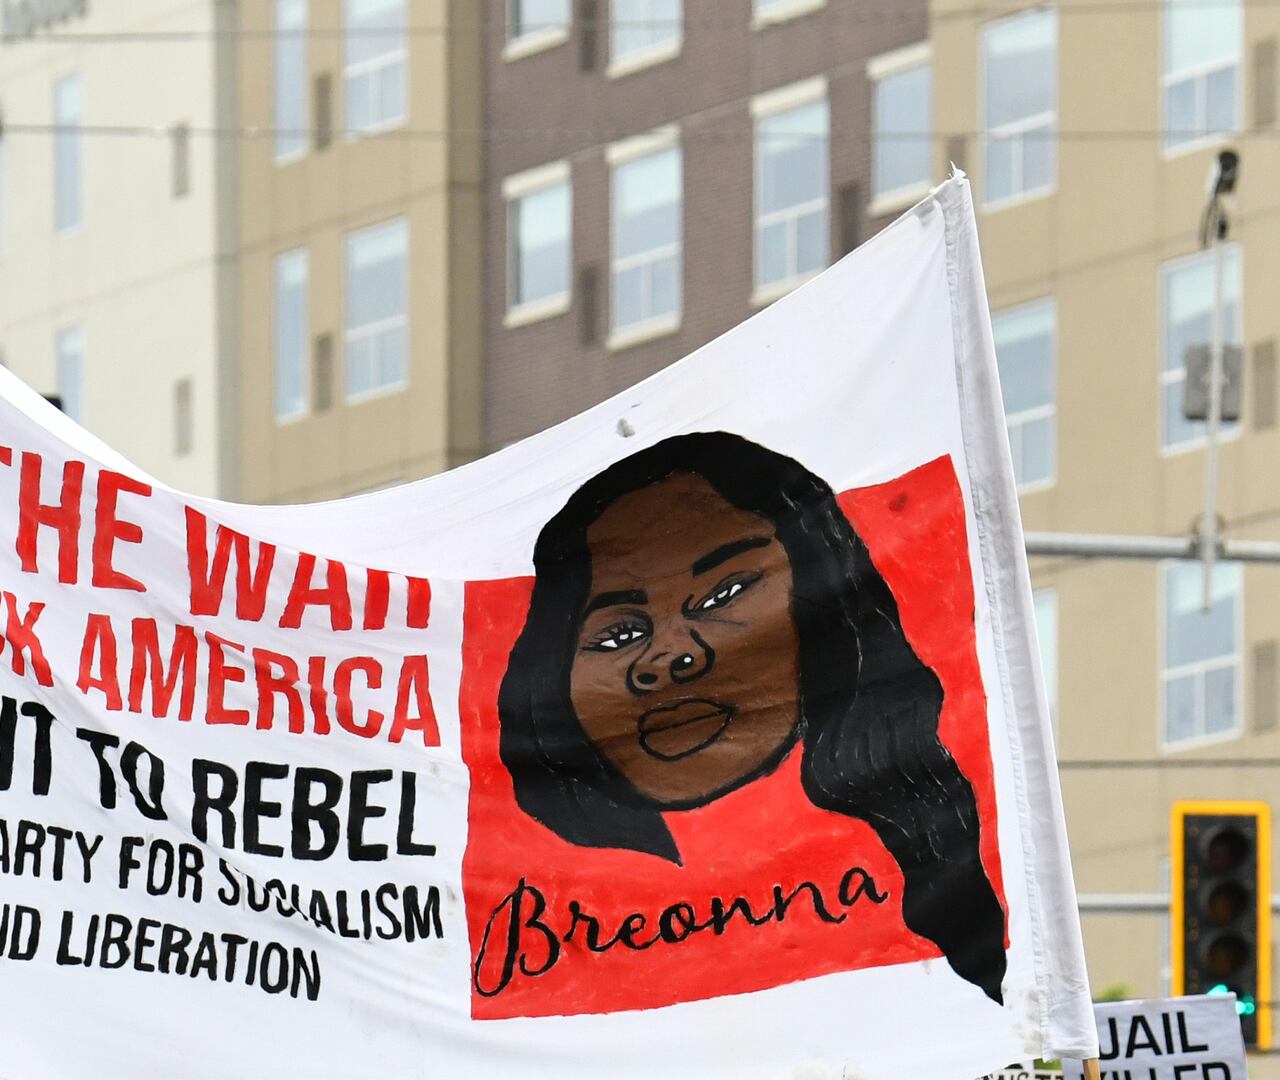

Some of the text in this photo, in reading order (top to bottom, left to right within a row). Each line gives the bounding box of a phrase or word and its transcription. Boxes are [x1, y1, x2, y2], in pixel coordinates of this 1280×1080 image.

[76, 612, 441, 747] AMERICA
[76, 728, 168, 820] TO
[192, 758, 436, 861] REBEL
[119, 835, 204, 902] FOR
[56, 911, 320, 1001] LIBERATION
[474, 866, 890, 997] Breonna
[1099, 1011, 1209, 1061] JAIL
